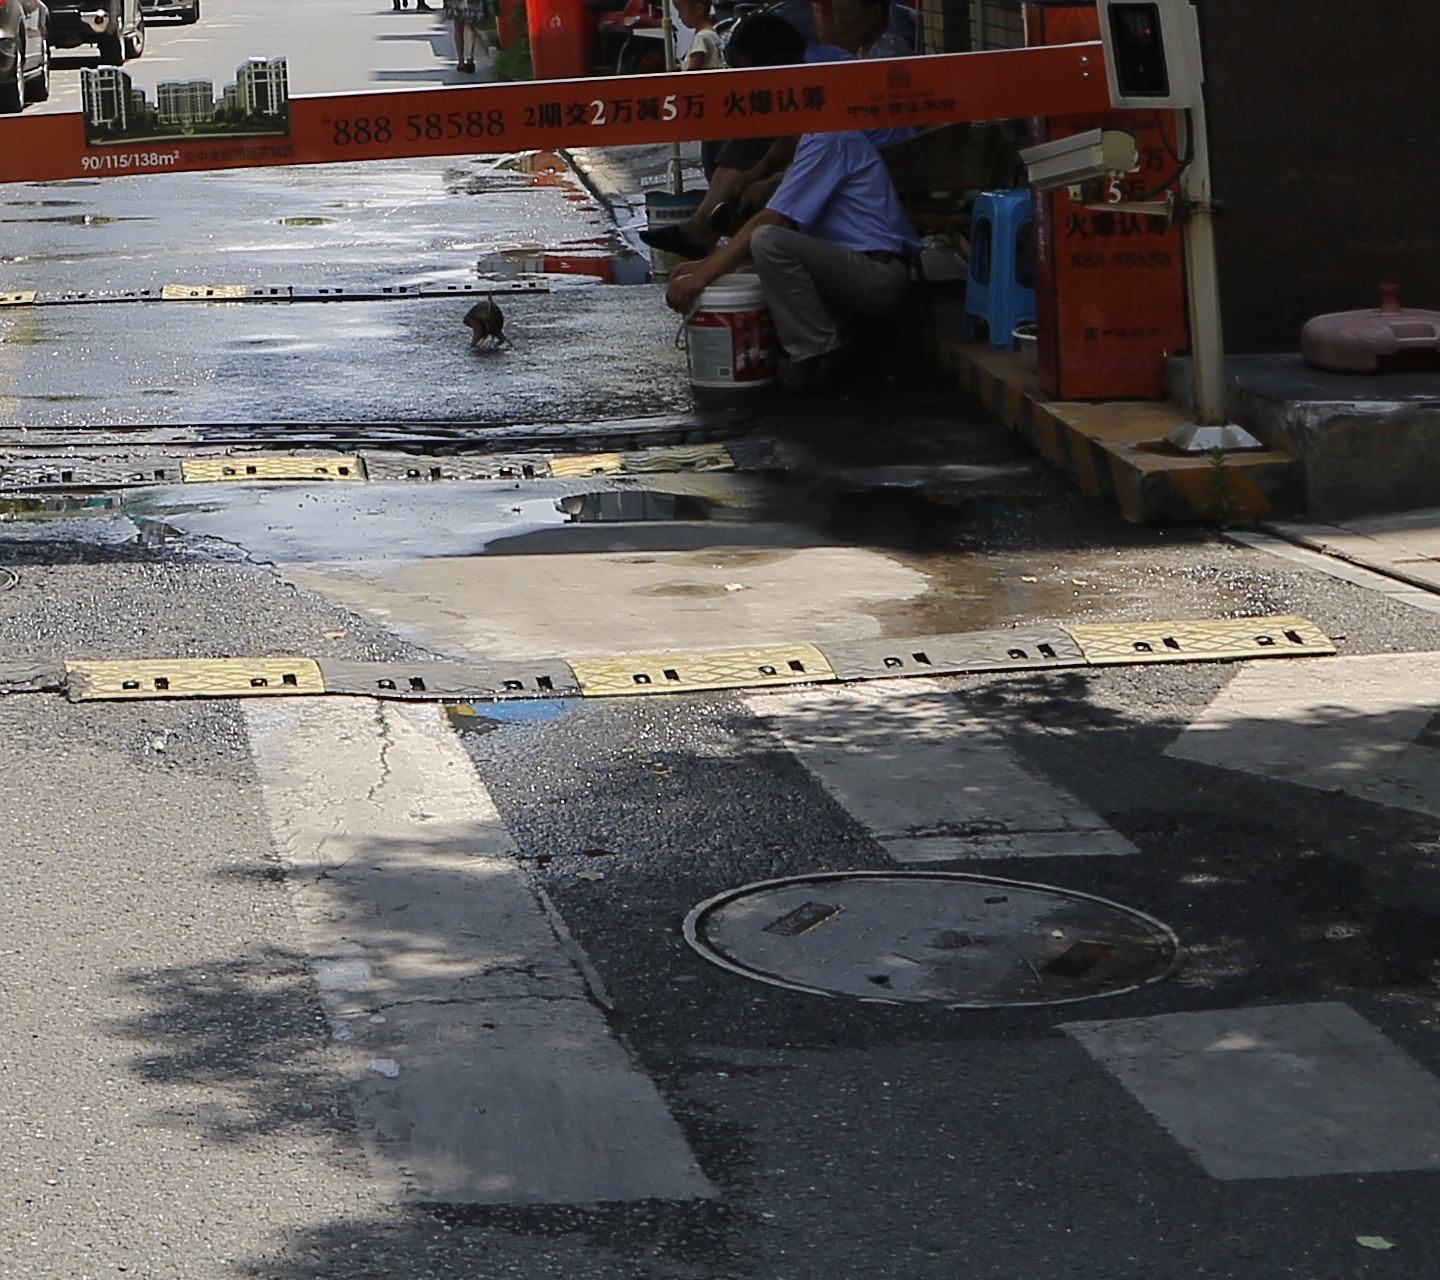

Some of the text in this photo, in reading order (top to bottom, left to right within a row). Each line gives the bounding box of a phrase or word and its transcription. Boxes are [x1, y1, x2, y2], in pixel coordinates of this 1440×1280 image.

[333, 109, 506, 146] 888 58588
[1071, 251, 1106, 269] 888
